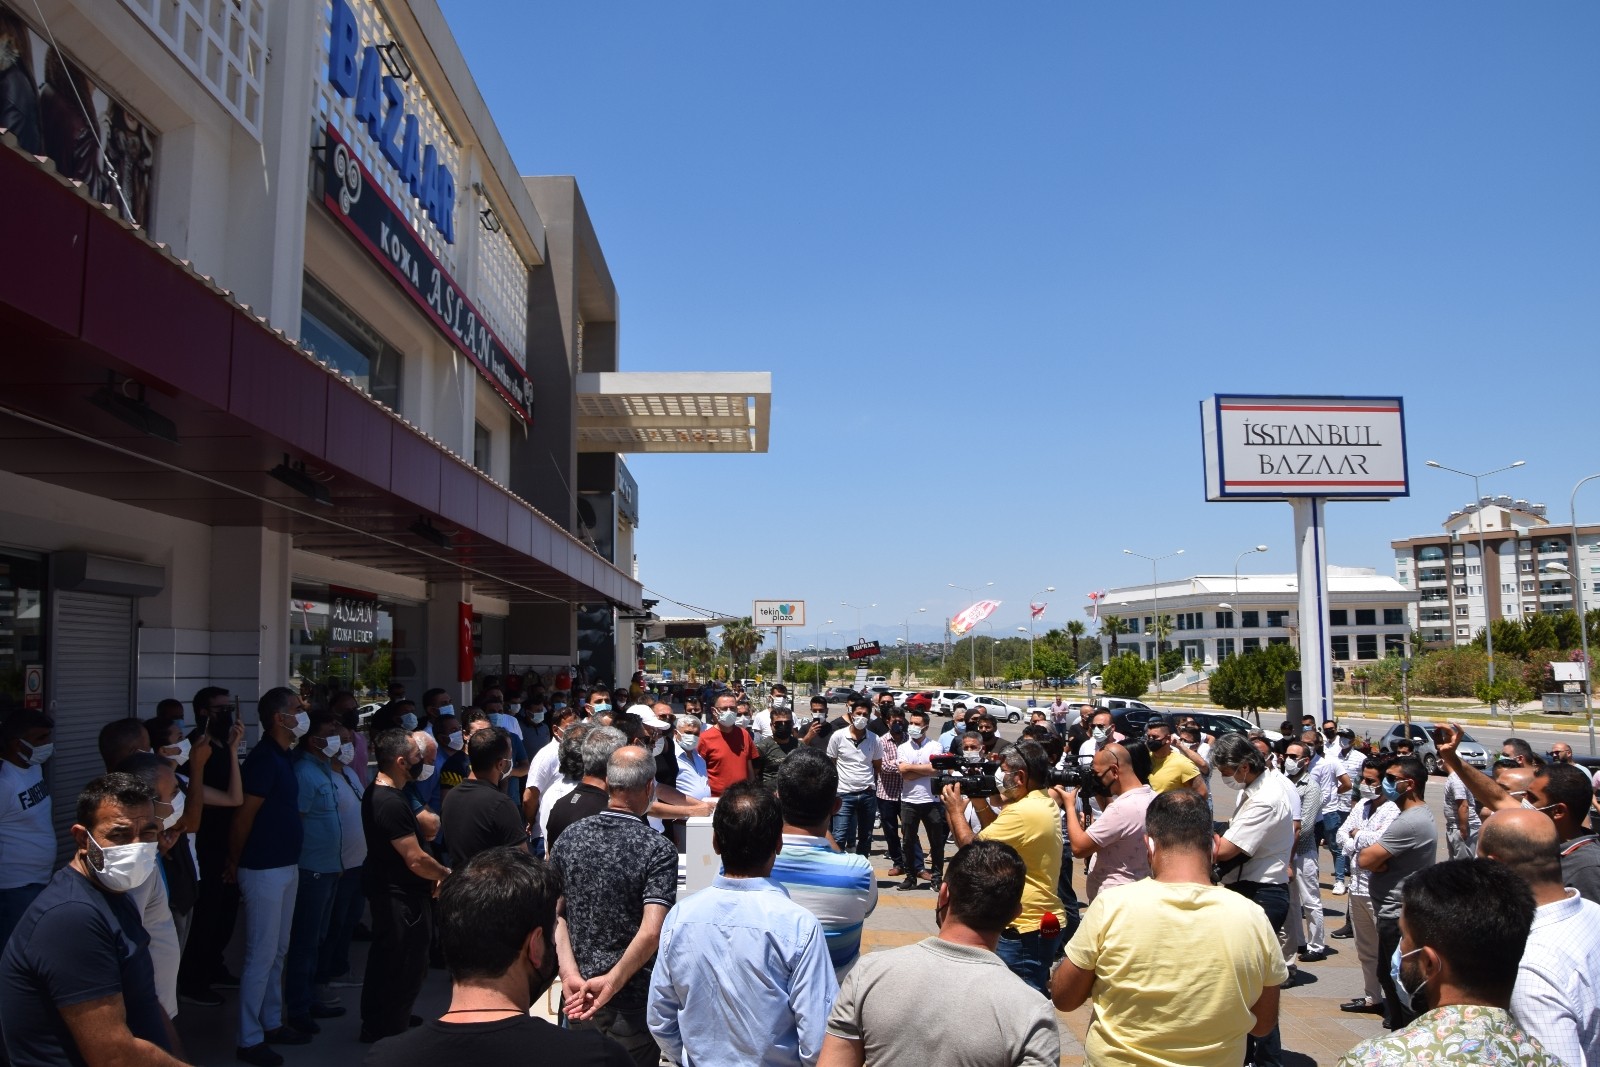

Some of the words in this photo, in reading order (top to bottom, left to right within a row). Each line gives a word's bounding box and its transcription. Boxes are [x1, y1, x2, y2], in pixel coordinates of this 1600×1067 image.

[427, 267, 492, 368] ASLAN
[1258, 453, 1370, 475] BAZAAR
[333, 596, 376, 624] ASLAN
[760, 607, 779, 616] tekin
[772, 613, 793, 623] plaza
